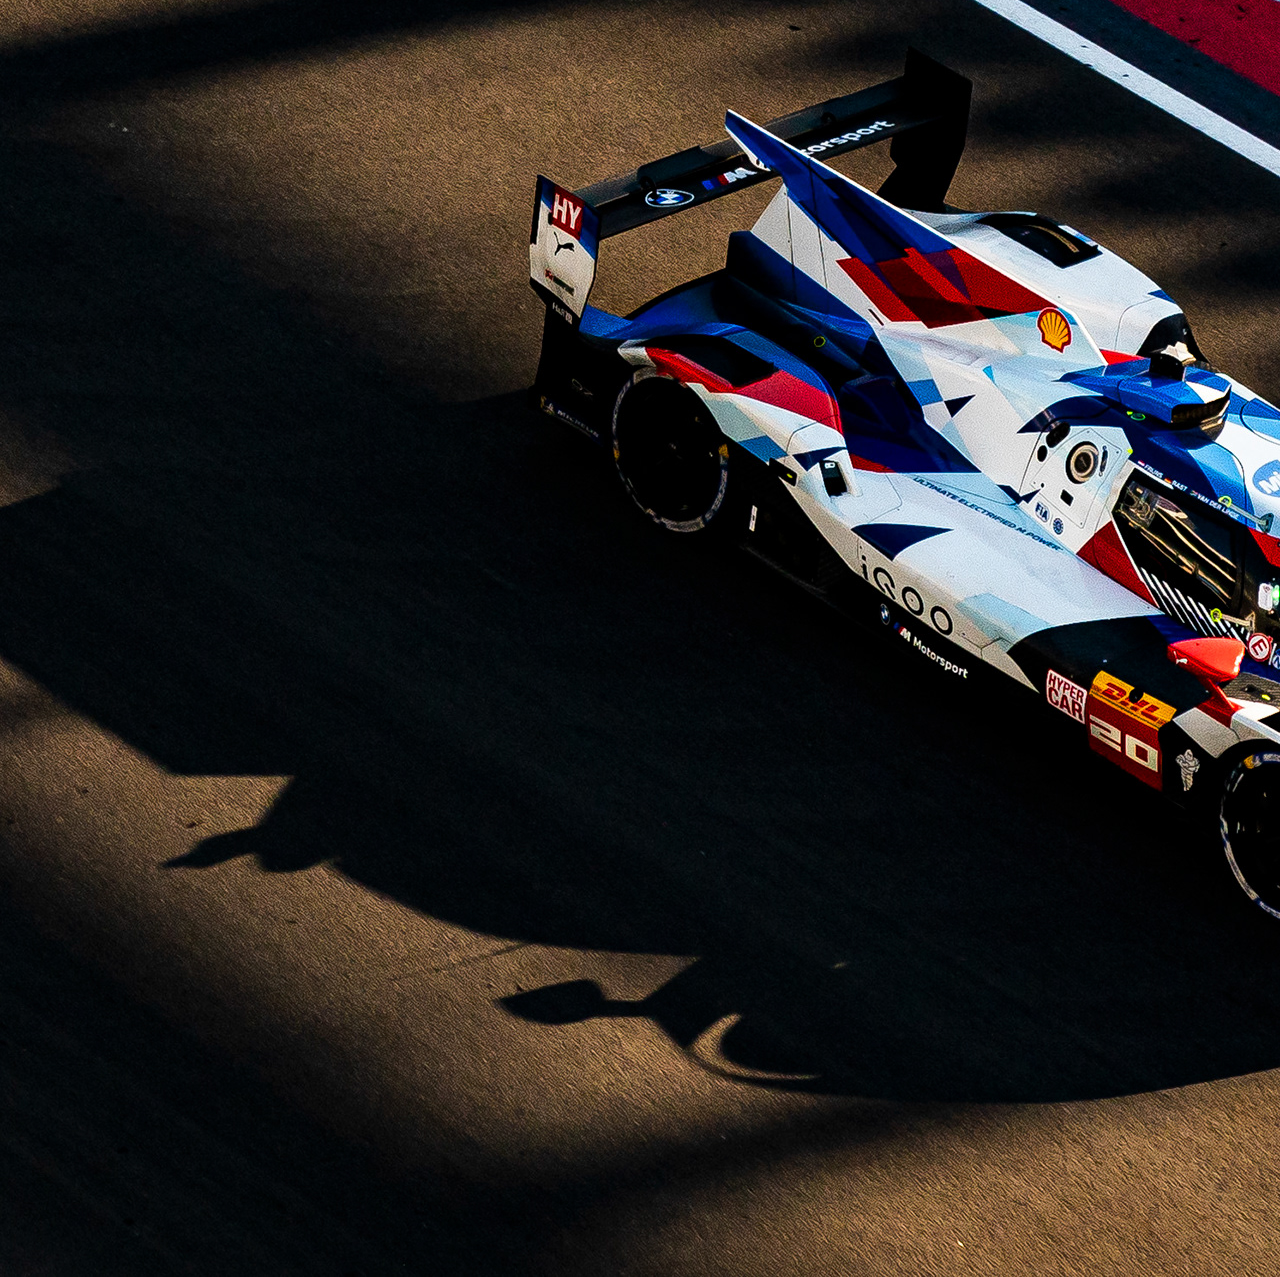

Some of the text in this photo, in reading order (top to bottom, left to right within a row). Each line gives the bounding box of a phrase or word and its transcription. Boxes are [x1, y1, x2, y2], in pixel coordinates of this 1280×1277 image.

[799, 119, 895, 156] orsport
[552, 193, 582, 230] HY
[913, 476, 959, 500] ULTIMATE
[958, 498, 1017, 528] ELECTRIFIED
[1025, 532, 1063, 552] POWER
[1035, 502, 1050, 522] FIA
[861, 554, 954, 636] iQOO
[912, 635, 969, 679] Motorsport
[1048, 671, 1085, 703] HYPER
[1048, 686, 1084, 722] CAR
[1089, 714, 1159, 773] 20
